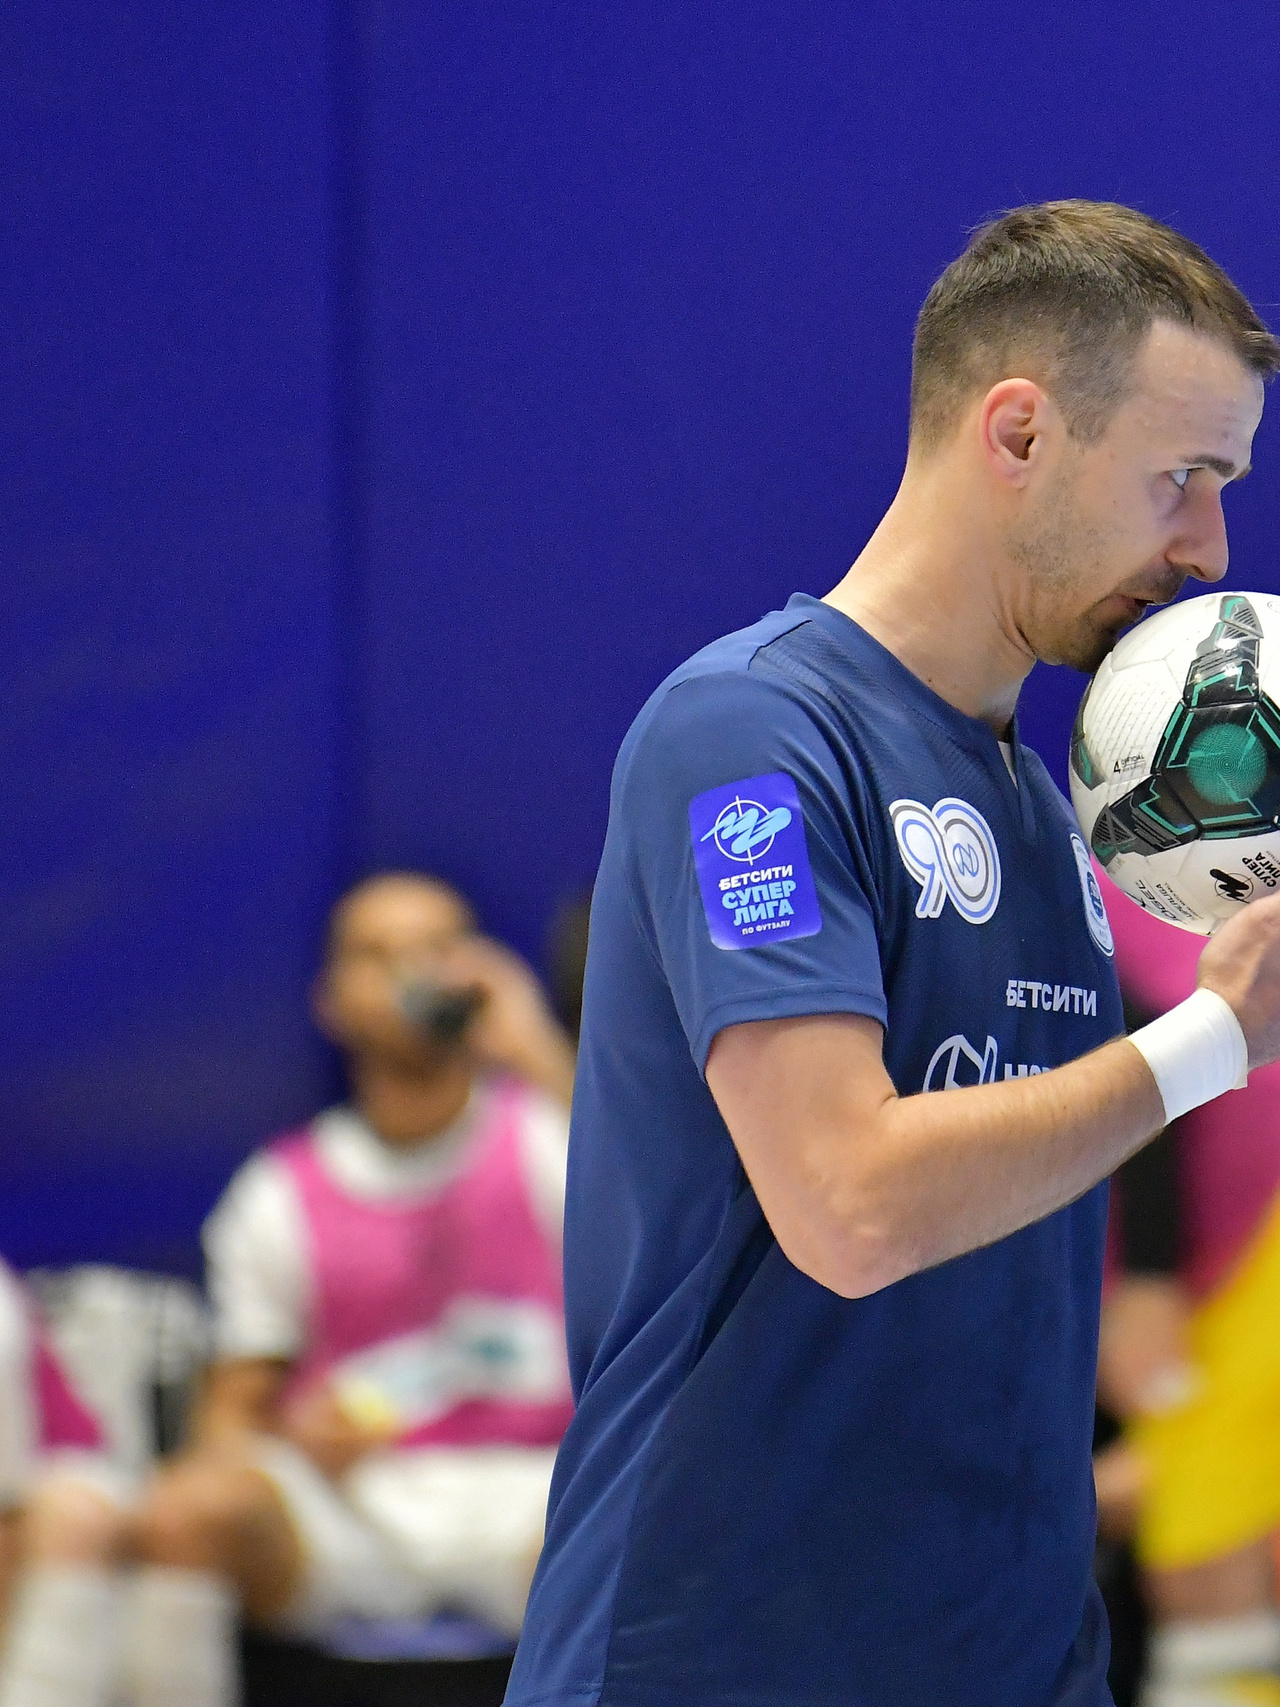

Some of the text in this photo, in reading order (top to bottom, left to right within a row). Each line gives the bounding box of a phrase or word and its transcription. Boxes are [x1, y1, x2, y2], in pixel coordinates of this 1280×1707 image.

[718, 864, 793, 891] БЕТСИТИ
[1241, 856, 1277, 888] СУПЕР
[722, 880, 796, 909] СУПЕР
[733, 899, 794, 926] ЛИГА
[741, 920, 791, 936] ПО ФУТЗАЛУ
[1006, 979, 1097, 1017] БЕТСИТИ
